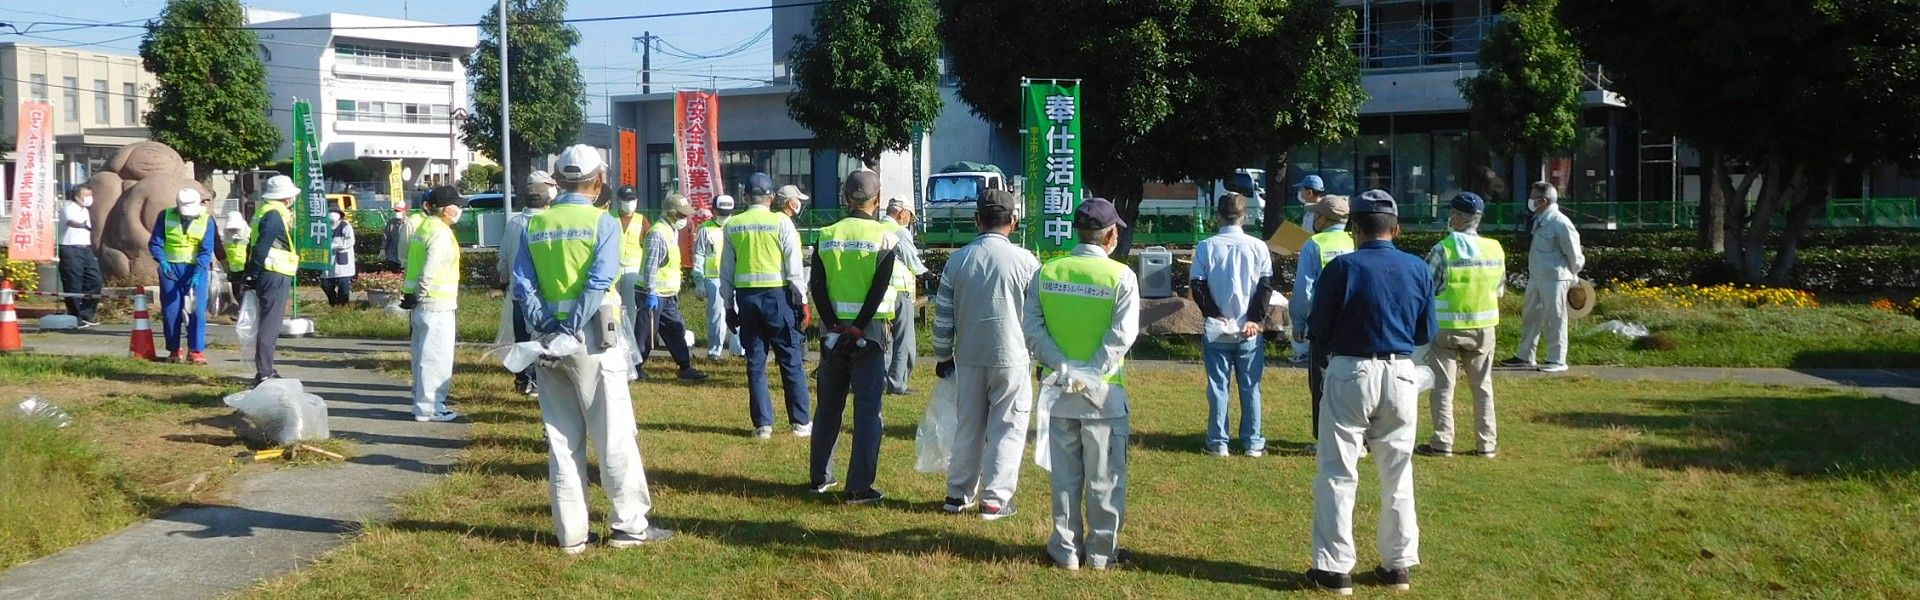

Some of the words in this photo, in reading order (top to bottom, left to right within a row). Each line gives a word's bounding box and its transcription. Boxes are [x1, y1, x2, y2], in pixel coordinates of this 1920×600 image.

[1044, 95, 1075, 245] 奉仕活動中
